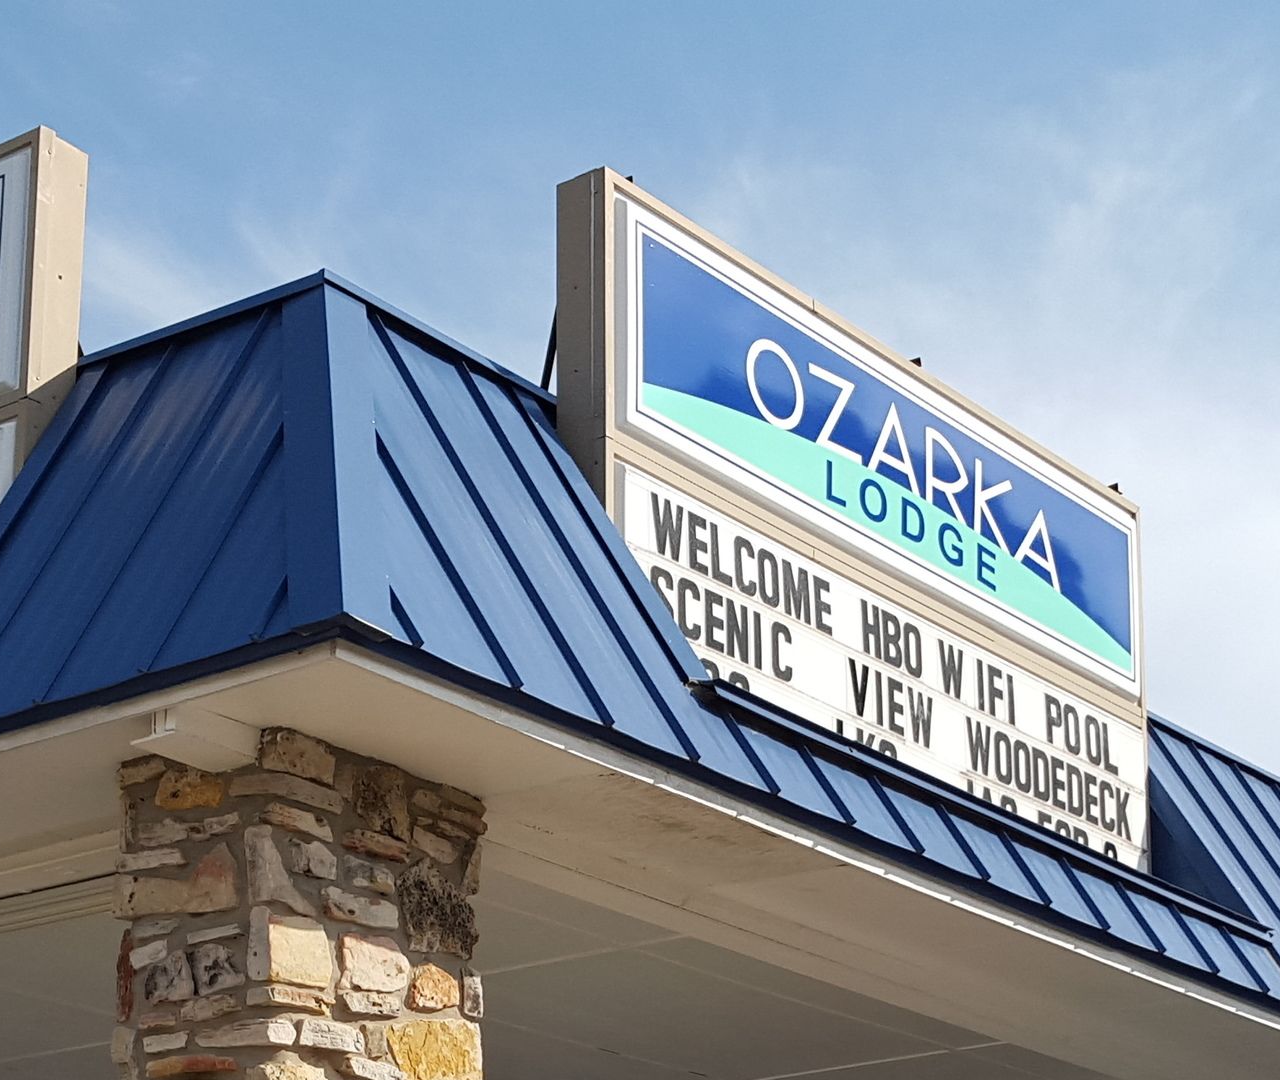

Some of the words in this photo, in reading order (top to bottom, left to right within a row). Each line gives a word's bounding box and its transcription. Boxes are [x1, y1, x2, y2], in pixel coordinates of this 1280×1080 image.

[746, 338, 1061, 592] OZARKA
[827, 459, 997, 591] LODGE
[650, 565, 793, 682] SCENIC
[849, 657, 933, 749] VIEW
[966, 716, 1132, 842] WOODEDECK
[651, 491, 833, 636] WELCOME
[861, 599, 922, 679] HBO
[1044, 693, 1119, 776] POOL
